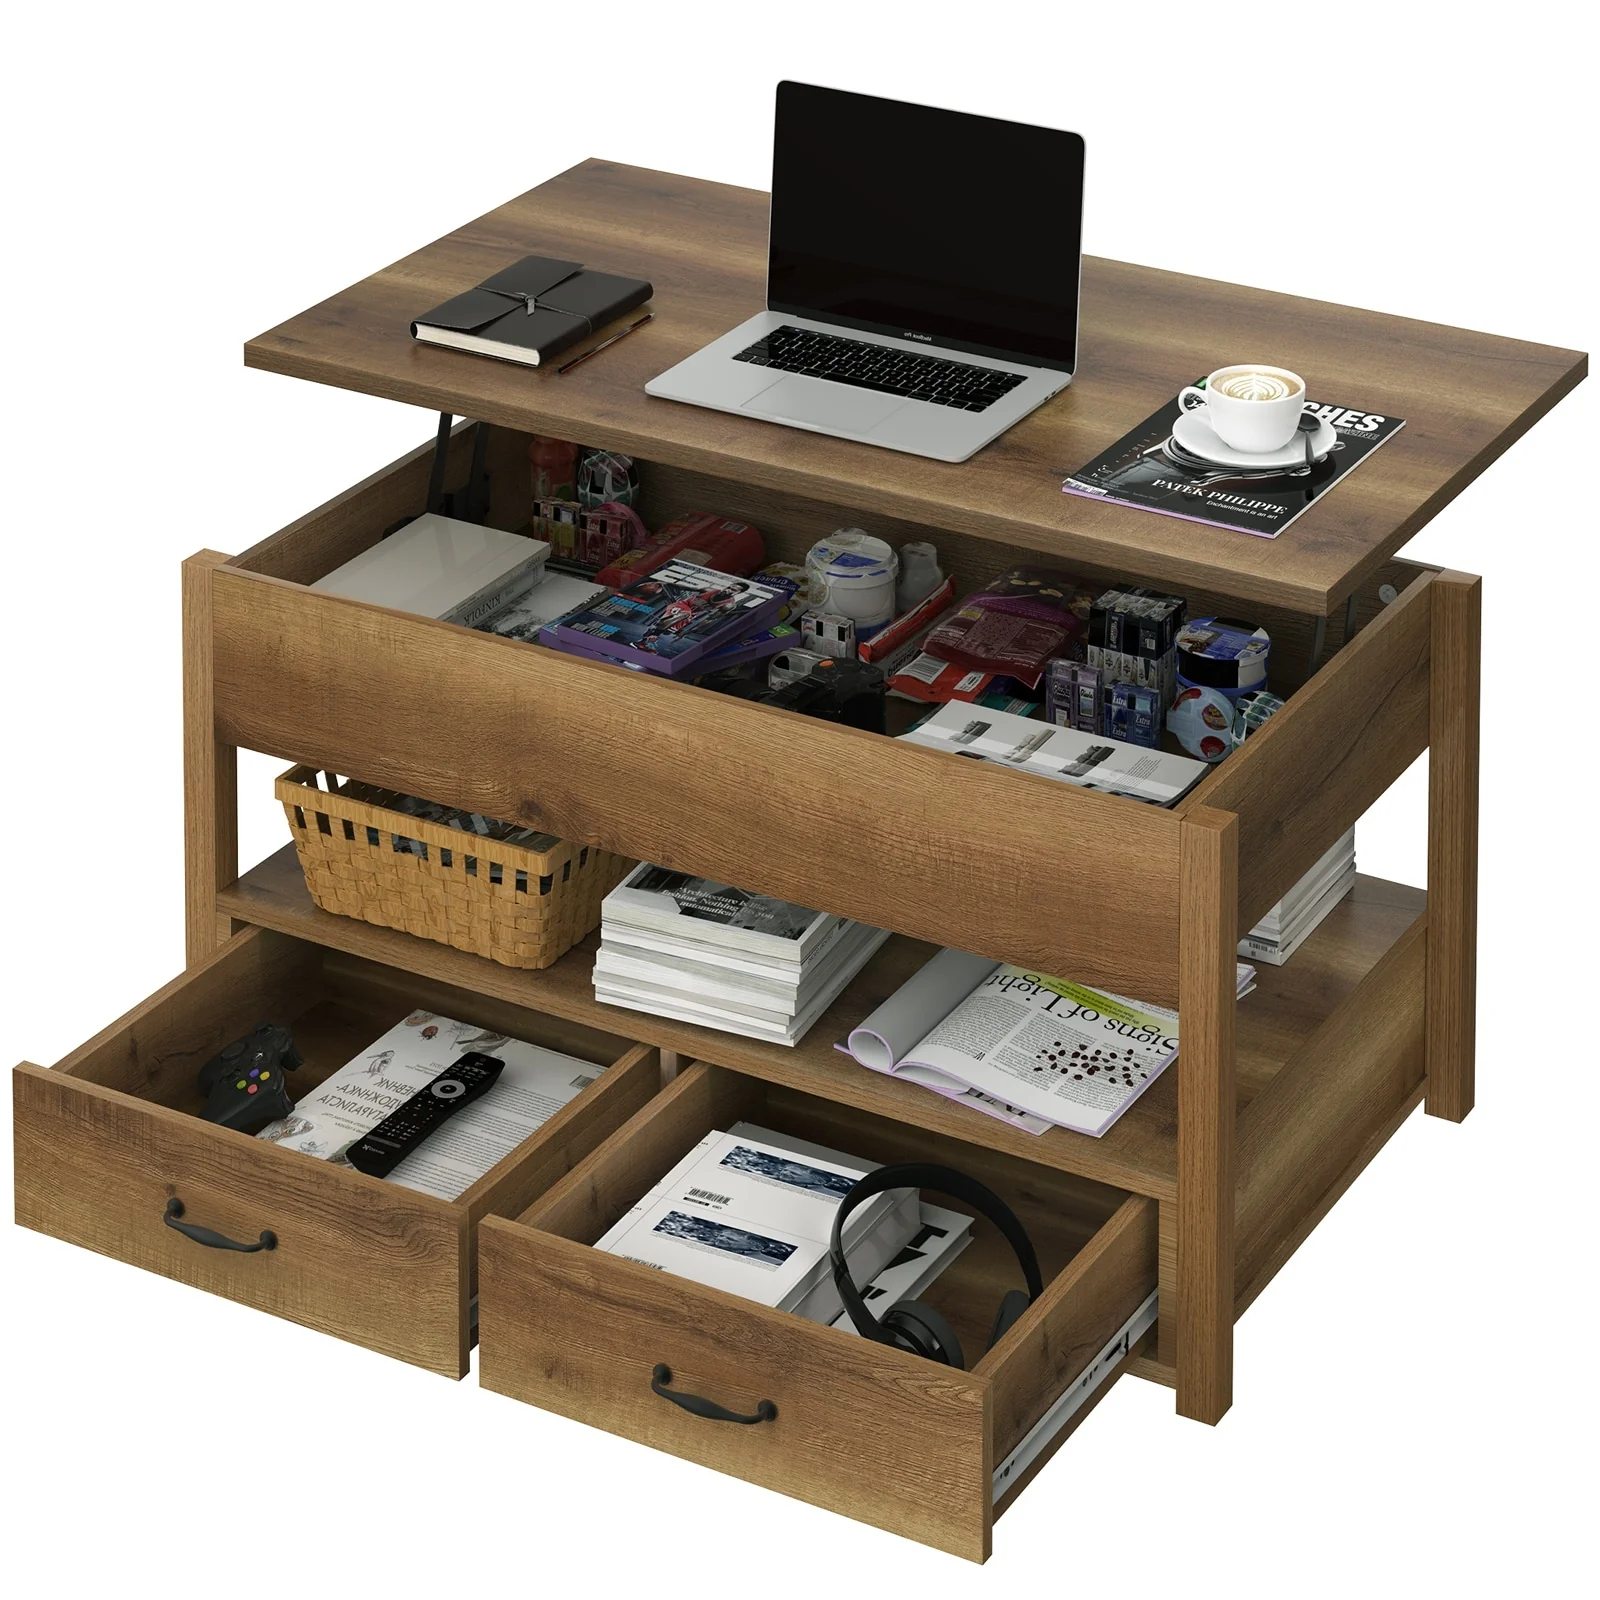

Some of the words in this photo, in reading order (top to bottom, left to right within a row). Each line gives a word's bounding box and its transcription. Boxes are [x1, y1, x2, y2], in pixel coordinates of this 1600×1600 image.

[1303, 401, 1386, 432] CHES
[1151, 479, 1208, 497] PATEK
[1207, 491, 1288, 515] PHILIPPE
[1206, 500, 1250, 514] Enchantment
[463, 594, 502, 627] KINFOLK
[983, 974, 1066, 1015] Light
[1057, 1002, 1100, 1022] of
[1103, 1018, 1179, 1057] Signs
